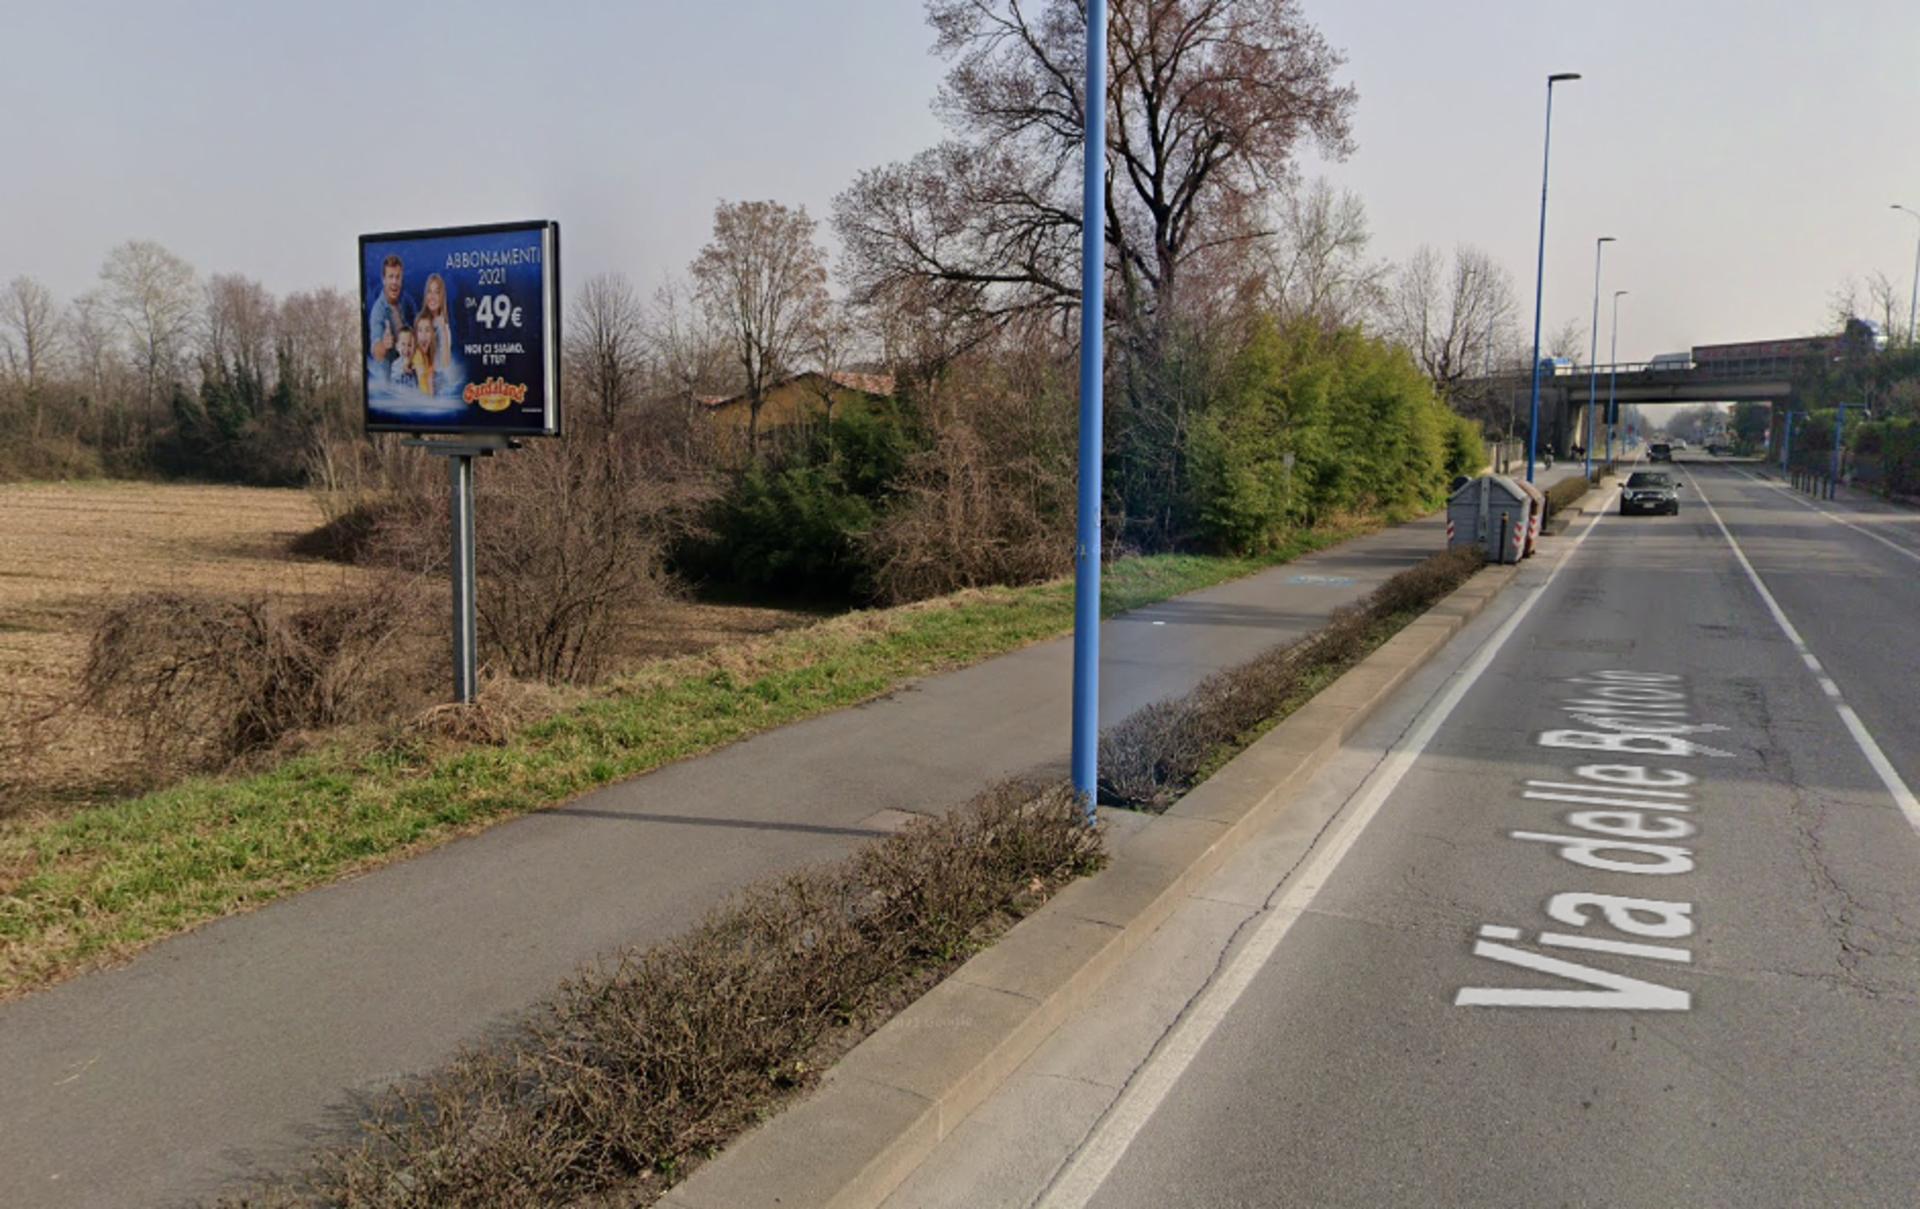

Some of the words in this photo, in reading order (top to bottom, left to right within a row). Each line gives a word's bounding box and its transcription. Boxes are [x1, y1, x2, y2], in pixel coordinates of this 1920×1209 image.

[446, 246, 541, 269] ABBONAMENTI
[478, 267, 506, 286] 2021
[476, 293, 523, 329] 49€
[464, 343, 482, 355] NOI
[483, 343, 492, 354] CI
